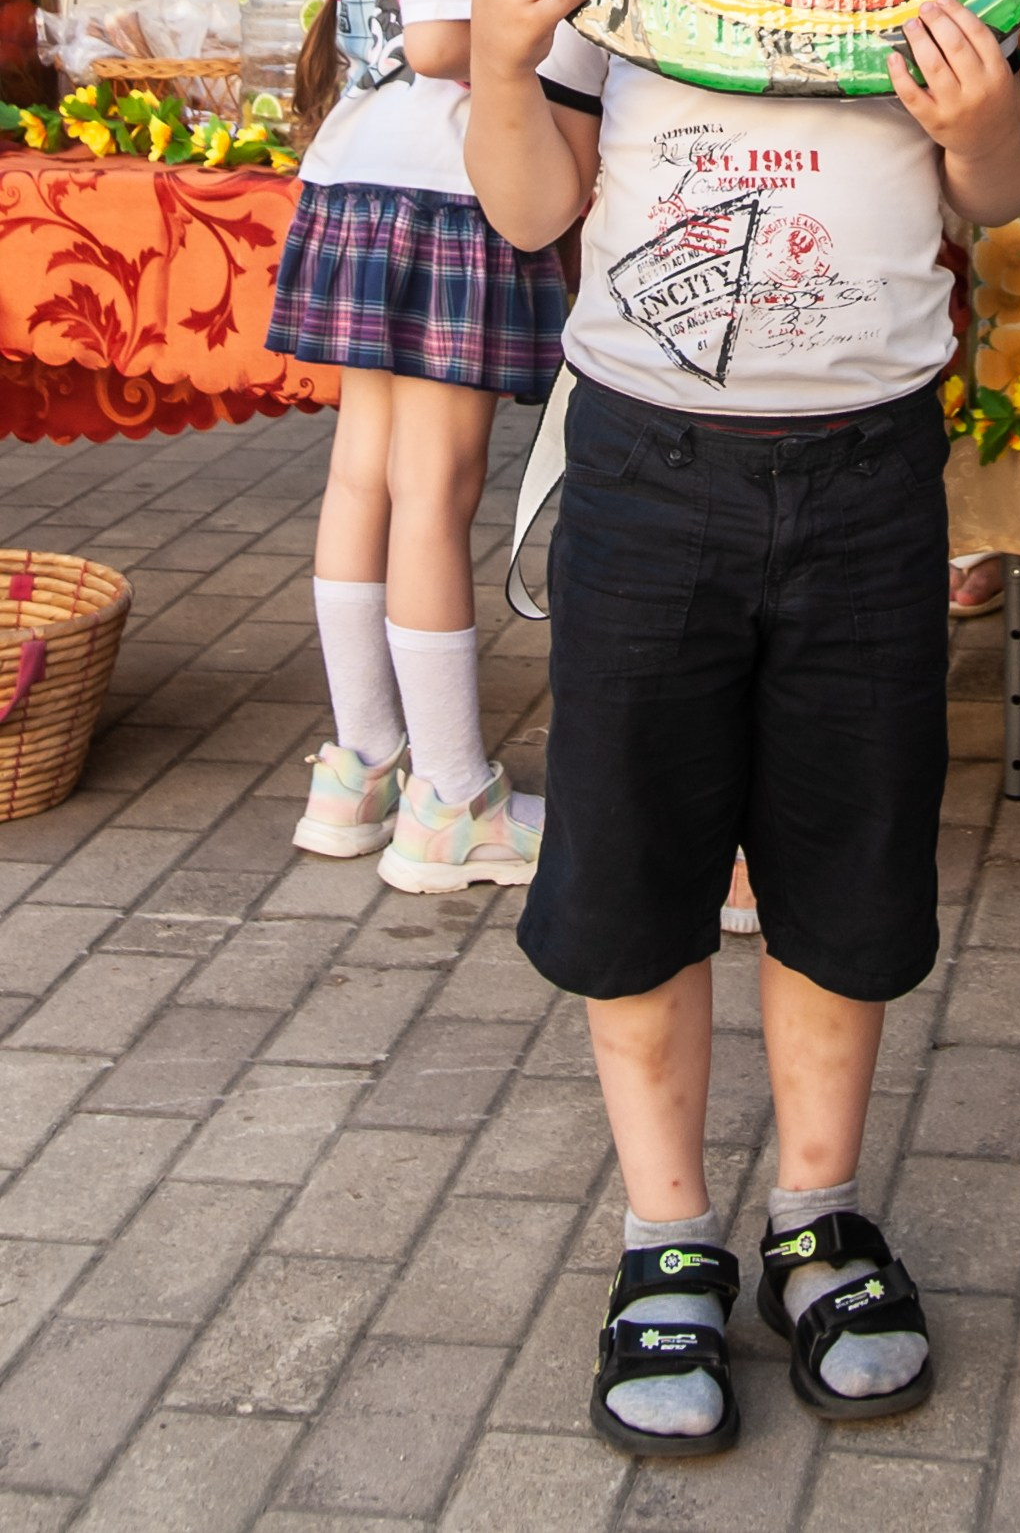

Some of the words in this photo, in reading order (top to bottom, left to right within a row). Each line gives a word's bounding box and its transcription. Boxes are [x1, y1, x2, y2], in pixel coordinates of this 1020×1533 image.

[747, 149, 821, 173] 1981
[790, 216, 820, 235] JEANS
[668, 321, 685, 337] LOS
